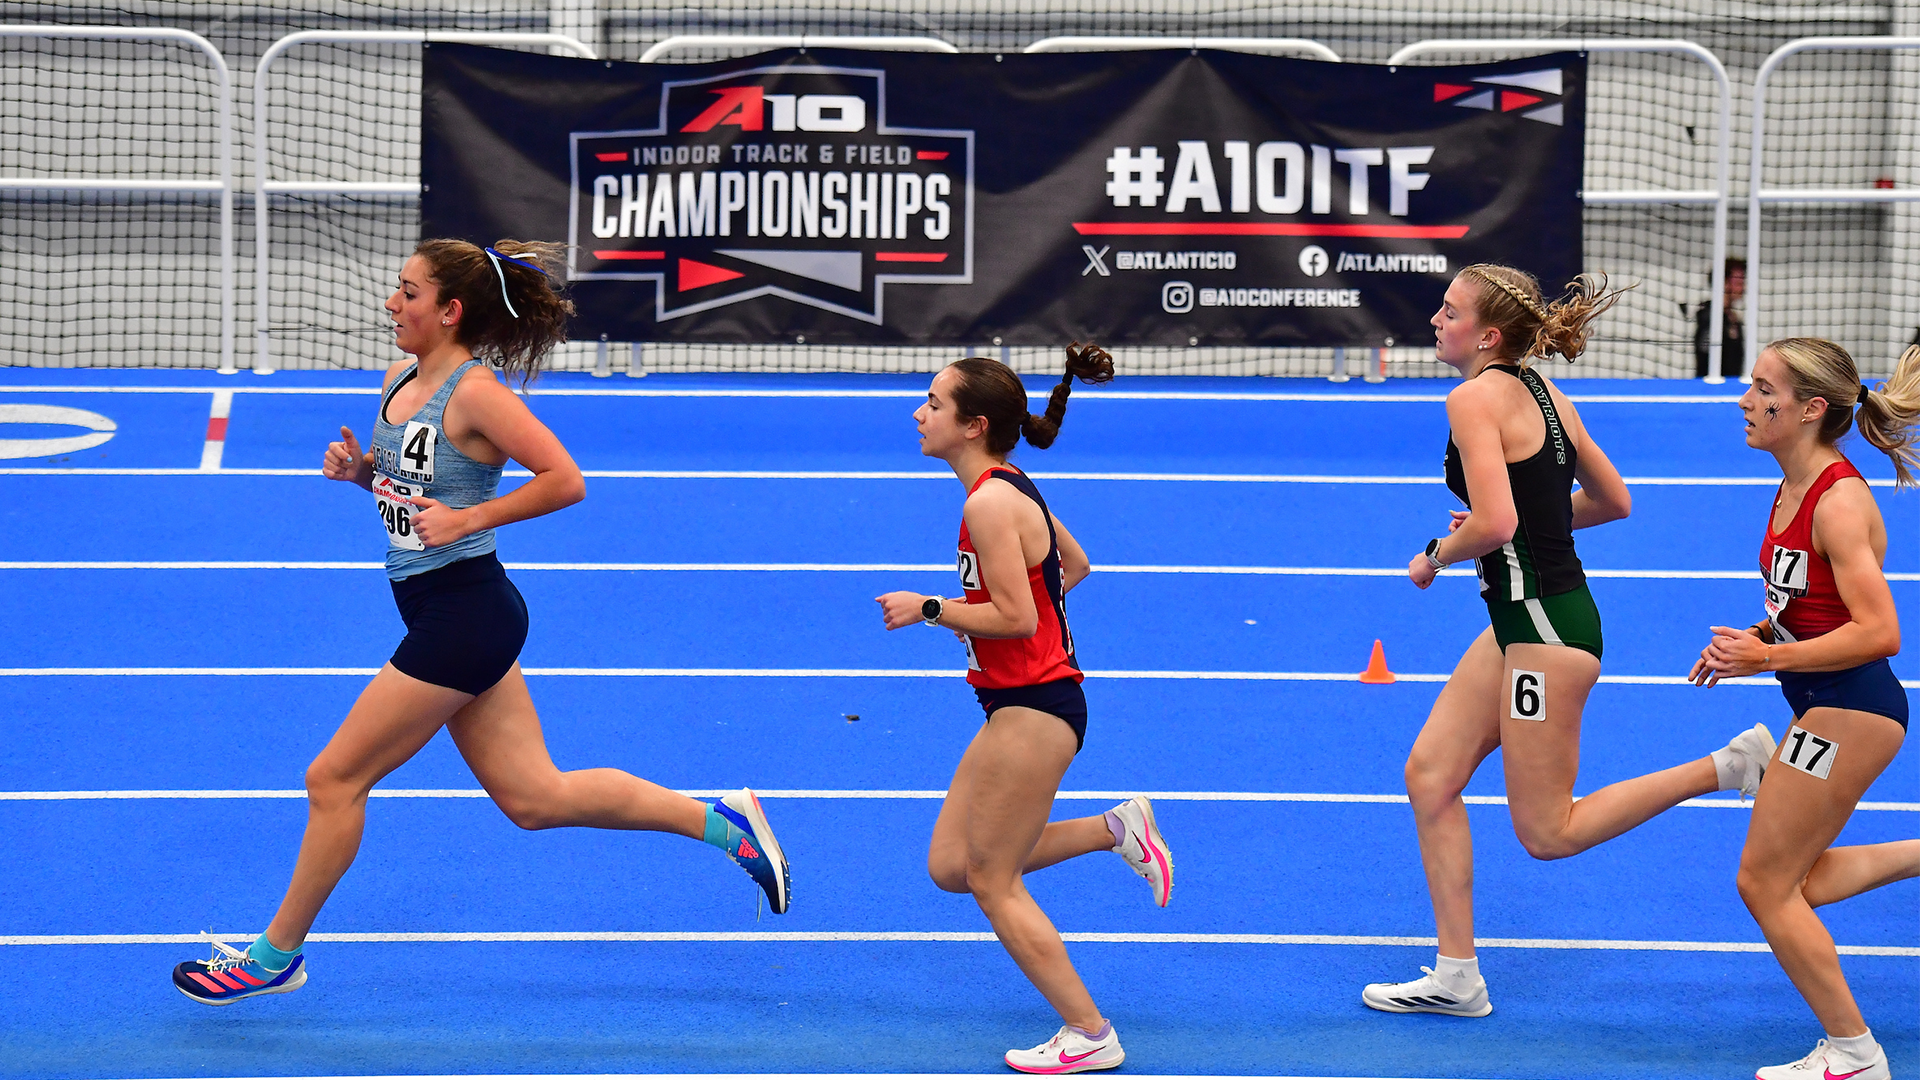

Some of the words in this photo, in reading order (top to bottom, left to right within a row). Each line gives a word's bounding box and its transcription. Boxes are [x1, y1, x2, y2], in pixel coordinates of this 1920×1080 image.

[680, 85, 866, 133] A10
[633, 145, 721, 166] INDOOR
[731, 144, 808, 165] TRACK
[819, 145, 834, 164] &
[845, 144, 912, 166] FIELD
[1105, 140, 1436, 216] #A10ITF
[591, 170, 951, 240] CHAMPIONSHIPS
[1115, 251, 1237, 271] @ATLANTIC10
[1335, 250, 1448, 274] /ATLANTIC10
[1198, 287, 1362, 309] @A10CONFERENCE
[1522, 373, 1567, 466] PATRIOTS
[403, 426, 430, 471] 4
[377, 500, 411, 537] 296
[1774, 547, 1801, 585] 17
[1514, 673, 1540, 717] 6
[1788, 730, 1832, 772] 17
